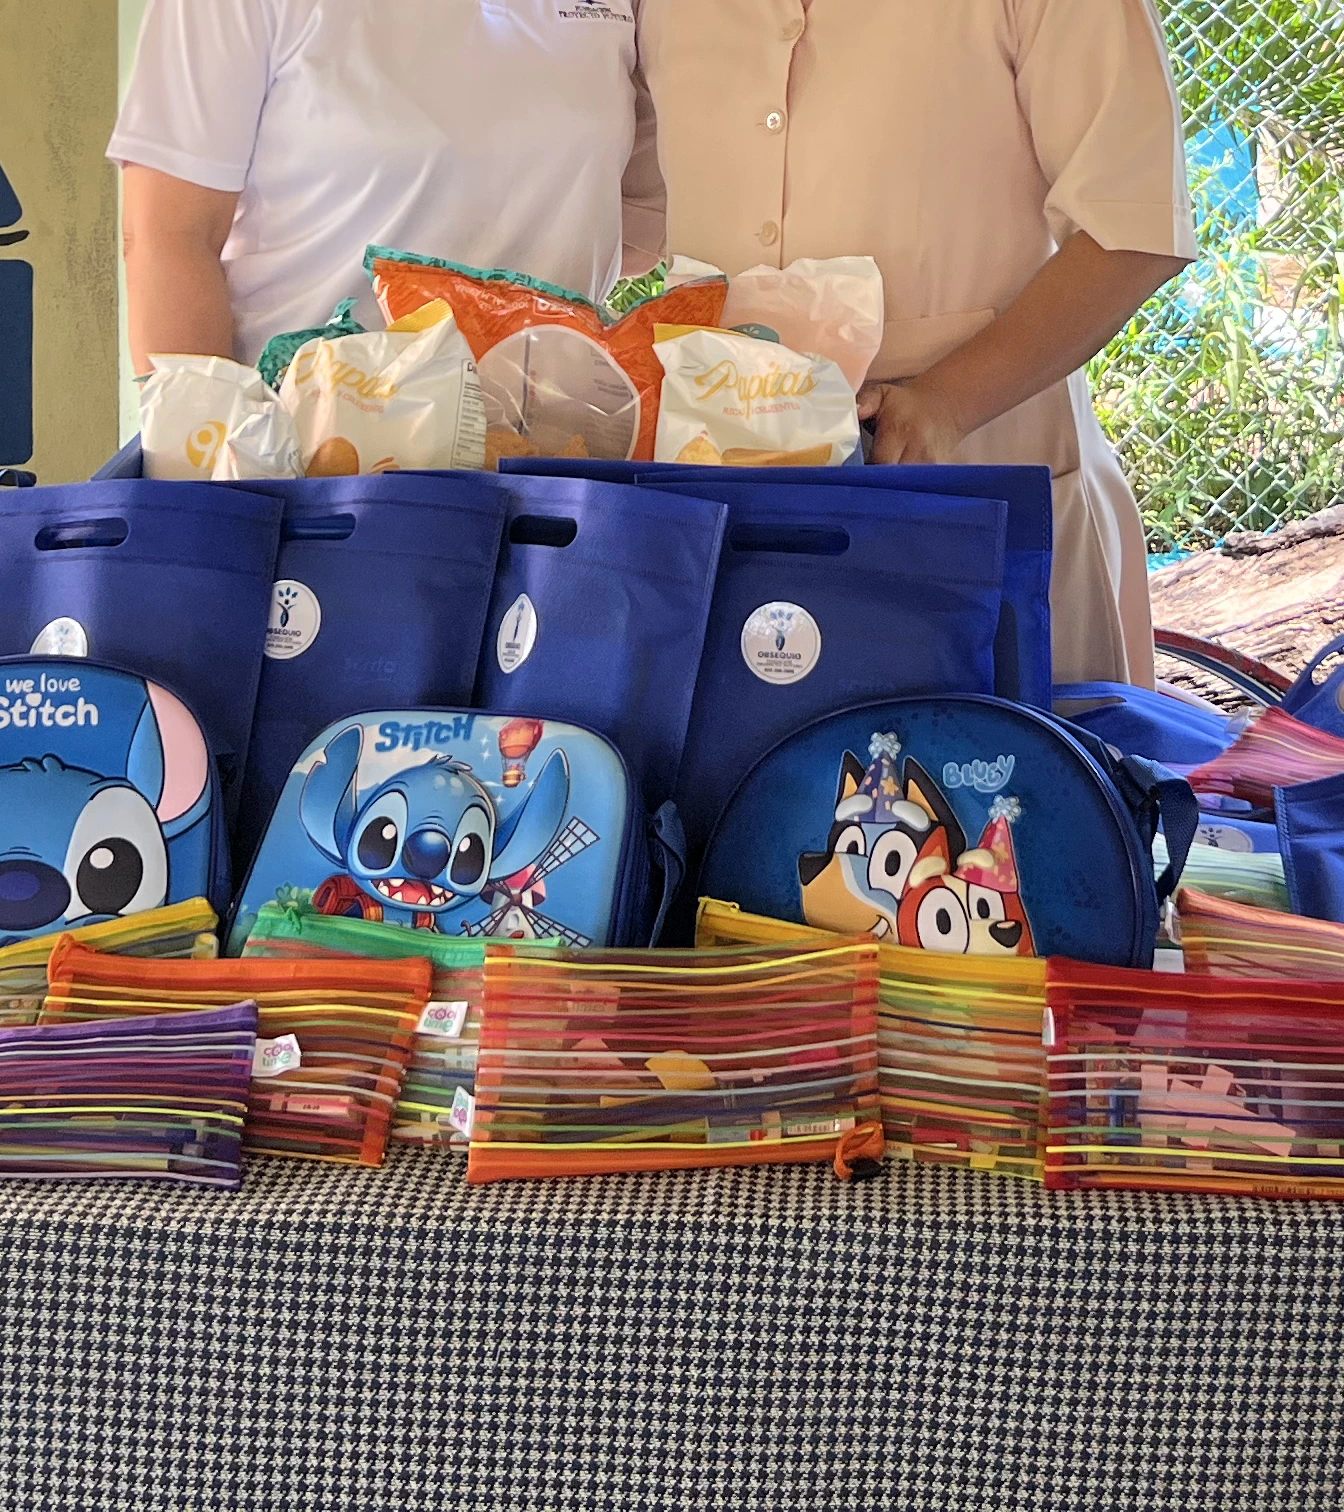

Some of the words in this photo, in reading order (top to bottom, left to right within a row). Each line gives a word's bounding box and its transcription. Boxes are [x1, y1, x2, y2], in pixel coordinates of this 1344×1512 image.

[694, 359, 820, 420] Papitas
[757, 650, 802, 660] OBSEQUIO
[5, 677, 35, 694] we
[39, 672, 81, 693] love
